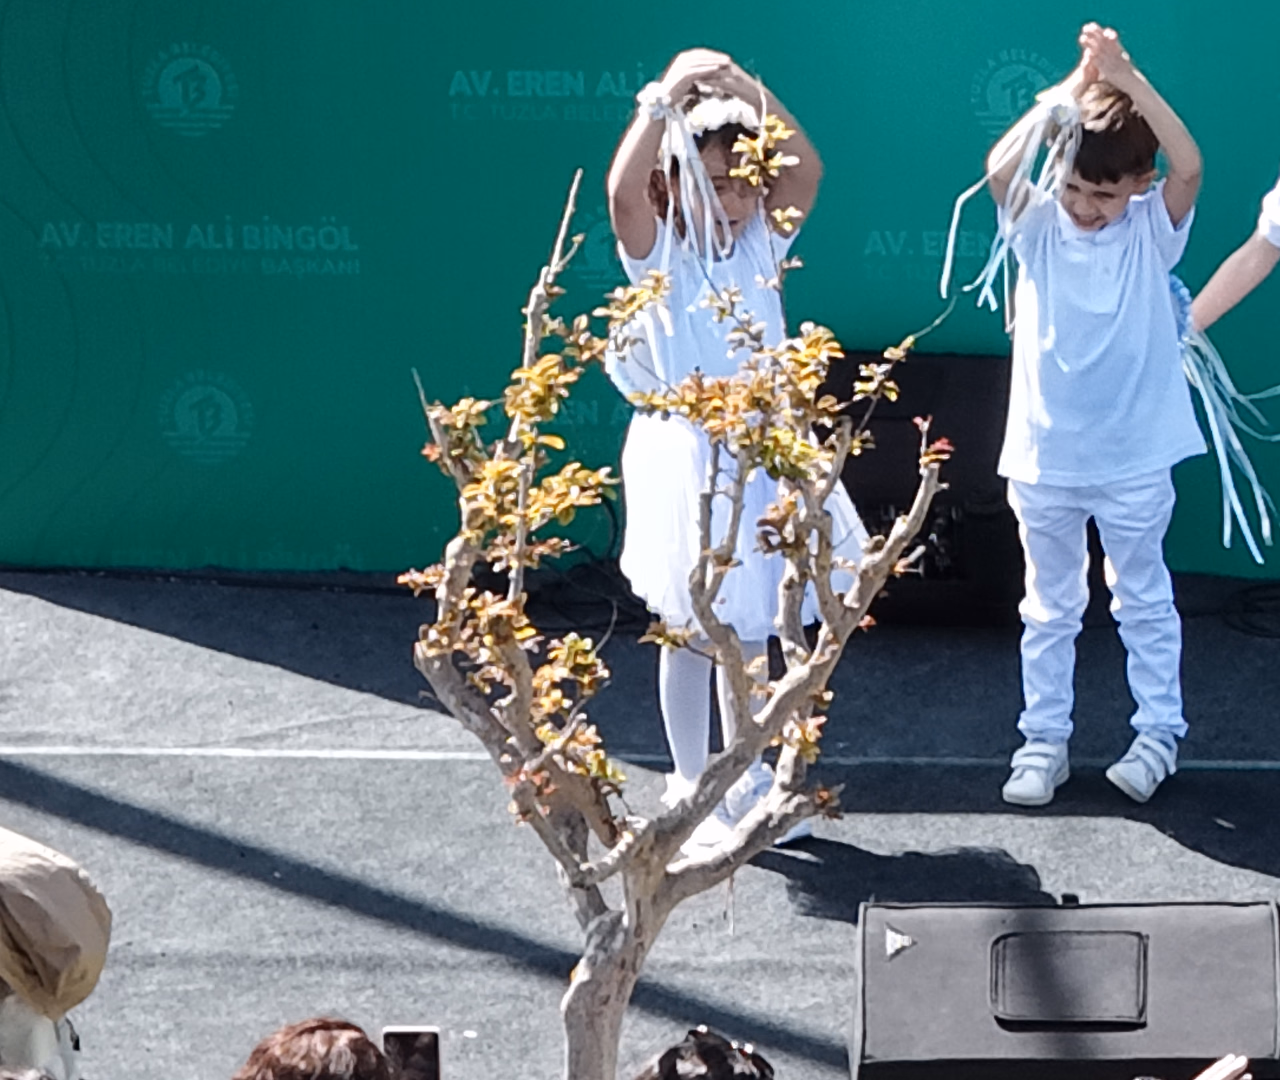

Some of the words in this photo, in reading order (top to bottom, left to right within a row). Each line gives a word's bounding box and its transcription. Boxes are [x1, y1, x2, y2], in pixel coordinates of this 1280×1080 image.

[507, 69, 585, 98] EREN
[96, 222, 174, 250] EREN
[183, 215, 234, 250] ALİ
[242, 215, 359, 251] BİNGÖL
